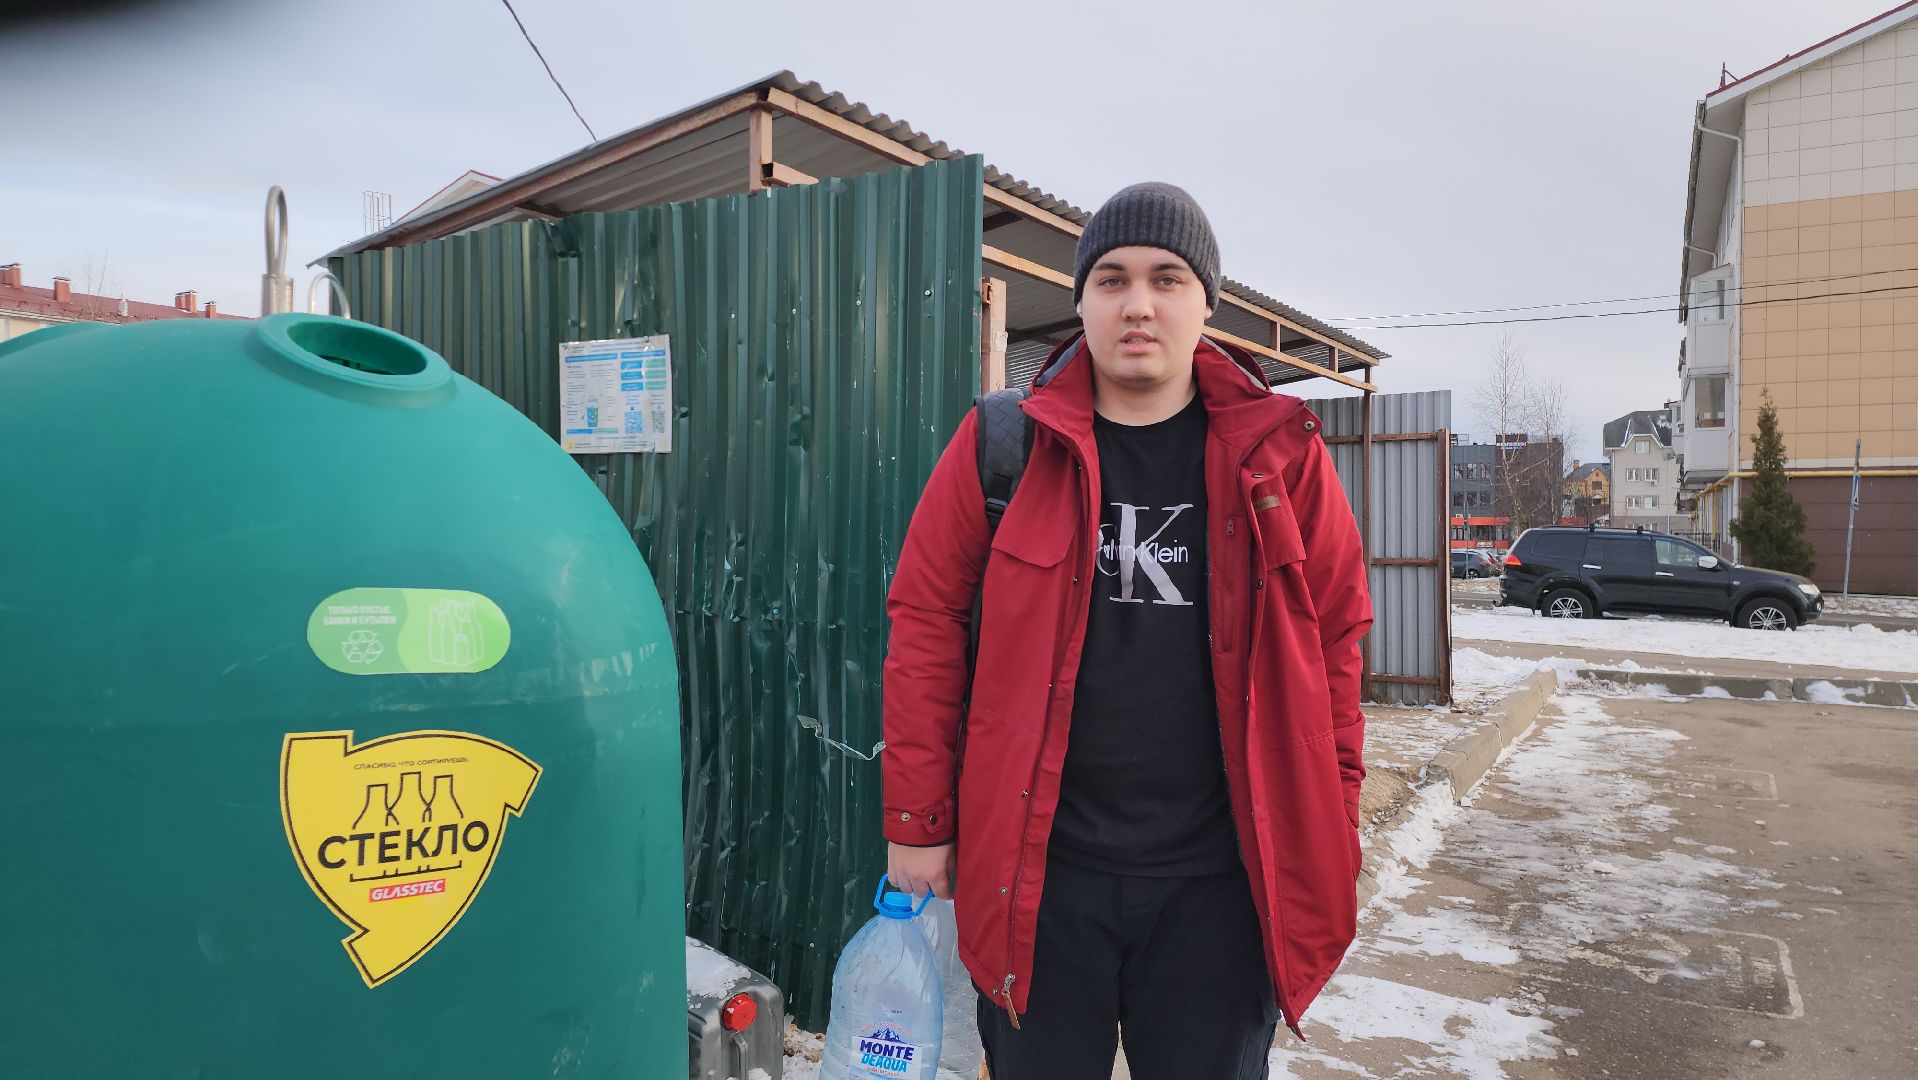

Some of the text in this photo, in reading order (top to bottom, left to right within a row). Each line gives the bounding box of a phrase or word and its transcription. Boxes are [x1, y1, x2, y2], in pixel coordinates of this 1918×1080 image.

[1139, 540, 1189, 563] Klein
[317, 820, 490, 869] СТЕКЛО
[371, 880, 445, 901] GLASSTEC
[860, 1039, 915, 1061] MONTE
[861, 1053, 908, 1073] DEAQUA
